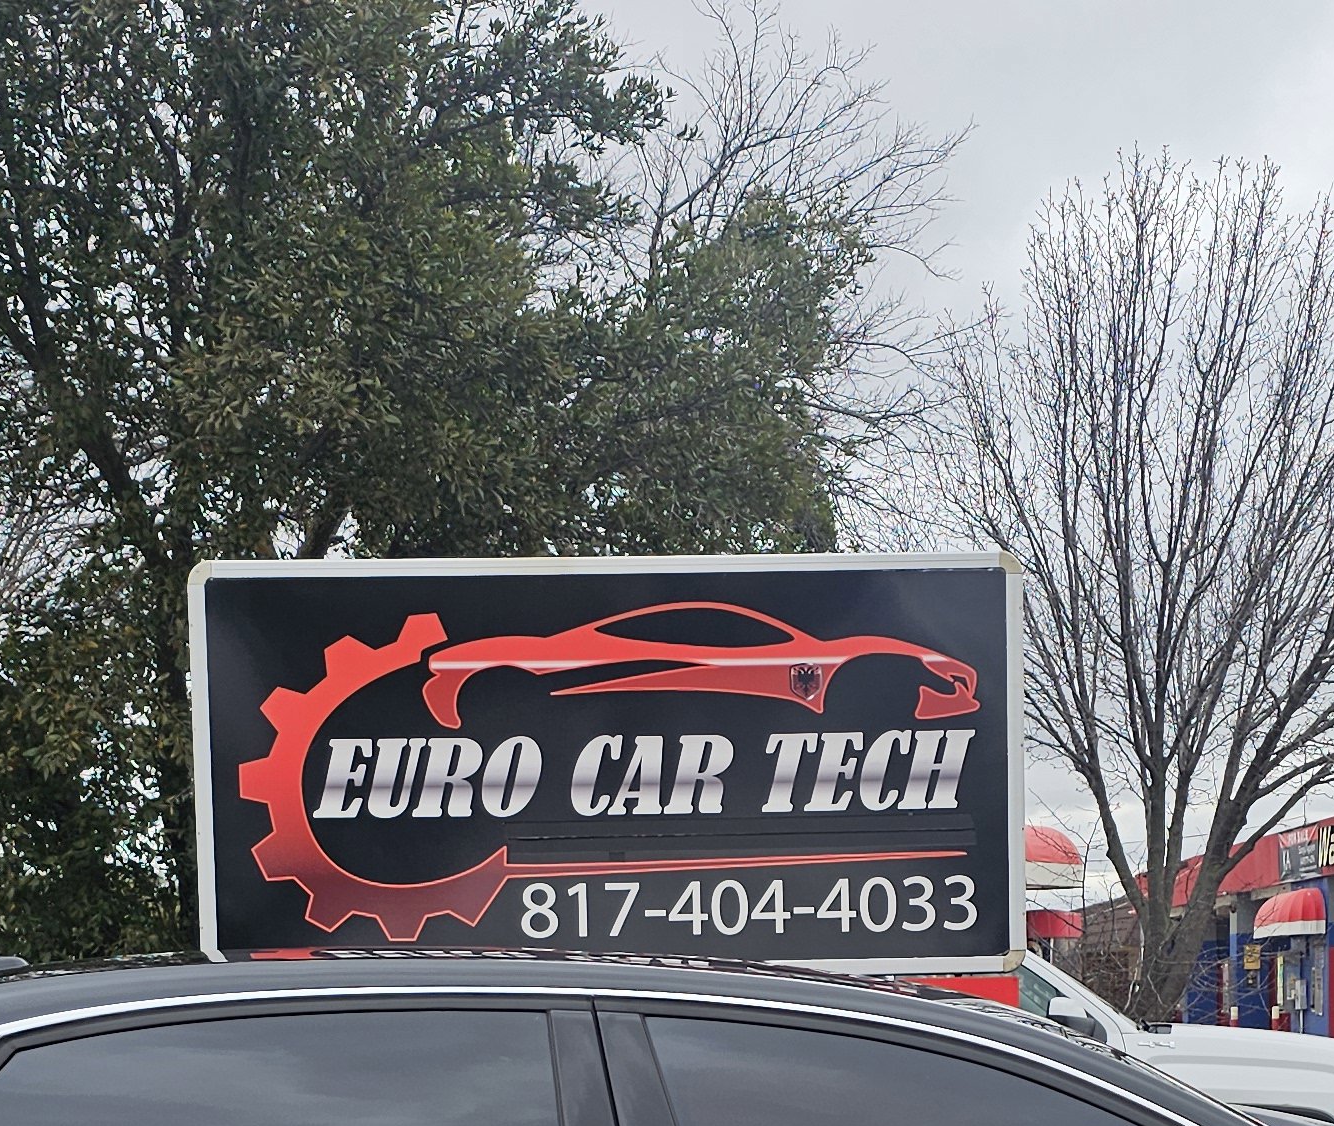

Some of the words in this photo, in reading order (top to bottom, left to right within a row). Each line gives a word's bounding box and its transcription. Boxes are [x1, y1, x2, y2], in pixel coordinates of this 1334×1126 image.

[312, 735, 544, 819] EURO
[570, 733, 735, 817] CAR
[762, 729, 976, 813] TECH
[520, 874, 979, 939] 817-404-4033
